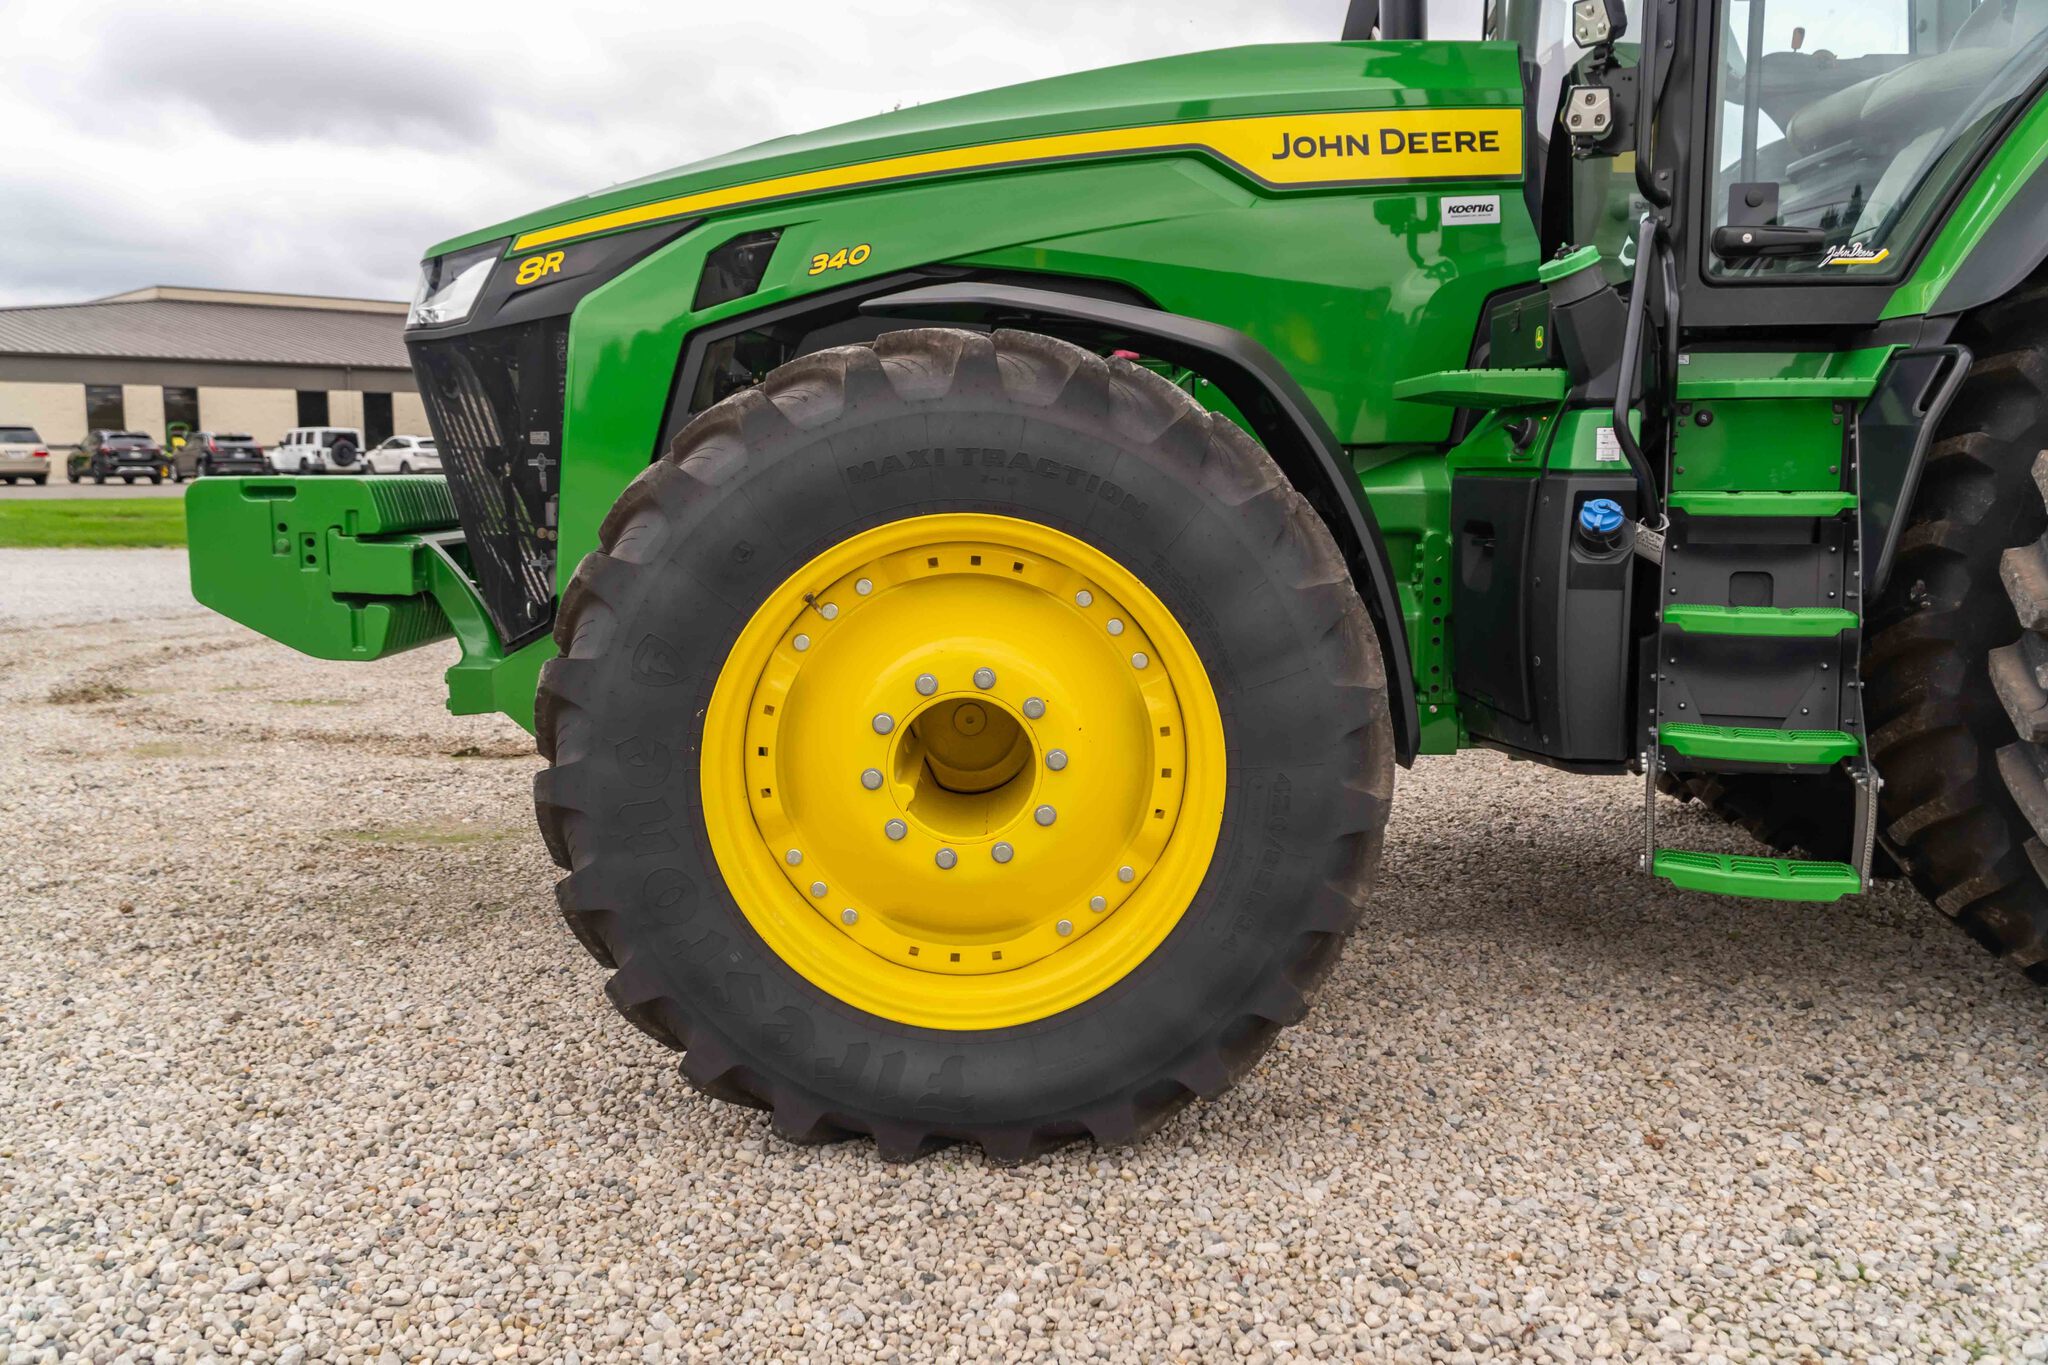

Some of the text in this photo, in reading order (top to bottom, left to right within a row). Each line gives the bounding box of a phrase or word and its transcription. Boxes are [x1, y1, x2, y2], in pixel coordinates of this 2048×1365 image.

[1272, 128, 1500, 160] JOHN DEERE
[515, 250, 565, 286] 8R
[807, 243, 871, 275] 340
[846, 447, 1150, 521] MAXI TRACTION
